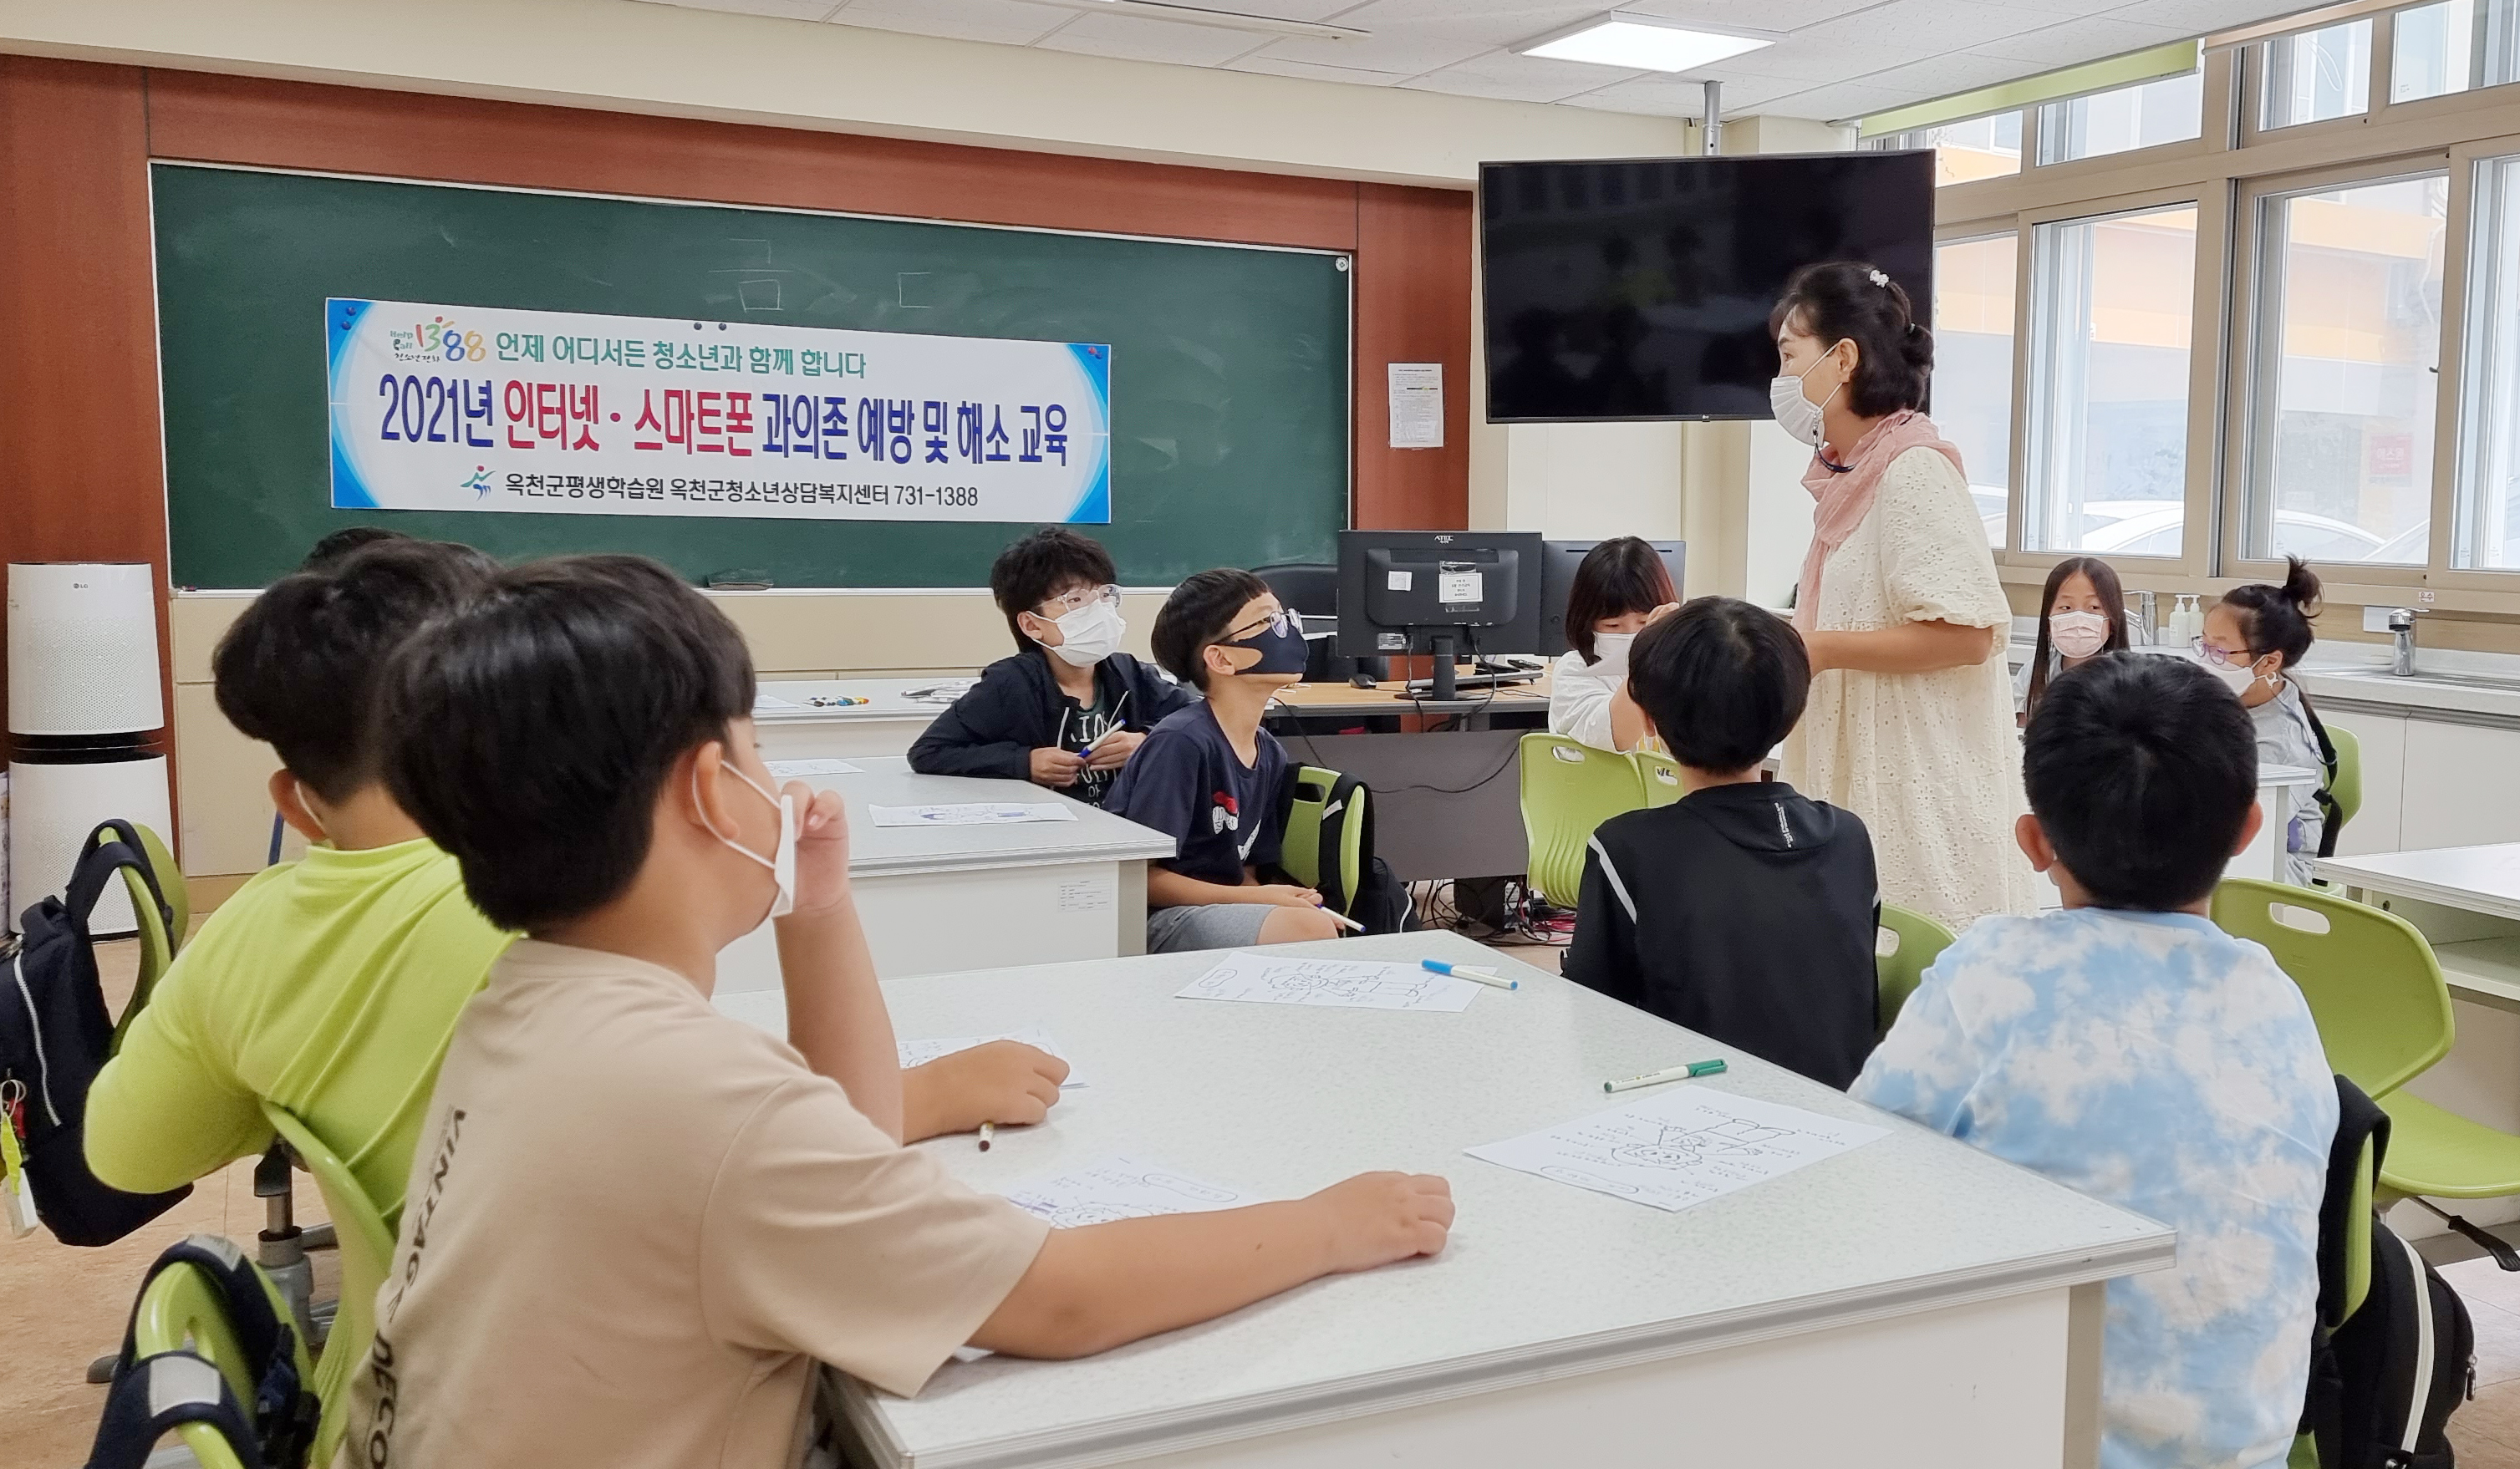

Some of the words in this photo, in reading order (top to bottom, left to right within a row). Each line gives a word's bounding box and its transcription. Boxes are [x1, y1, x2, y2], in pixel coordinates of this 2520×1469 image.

[390, 330, 414, 339] Help
[415, 323, 486, 362] 1388
[496, 332, 544, 363] 언제
[552, 337, 645, 366] 어디서든
[652, 341, 742, 373] 청소년과
[749, 347, 793, 375] 함께
[800, 349, 866, 379] 합니다
[379, 373, 493, 448] 2021년
[634, 389, 753, 458] 스마트폰
[761, 393, 849, 460] 과의존
[856, 397, 915, 464] 예방
[923, 400, 949, 464] 및
[956, 400, 1011, 465] 해소
[1018, 404, 1068, 467] 교육
[505, 473, 665, 501] 옥천군평생학습원
[669, 478, 888, 506] 옥천군청소년상담복지센터
[893, 485, 979, 507] 731-1388
